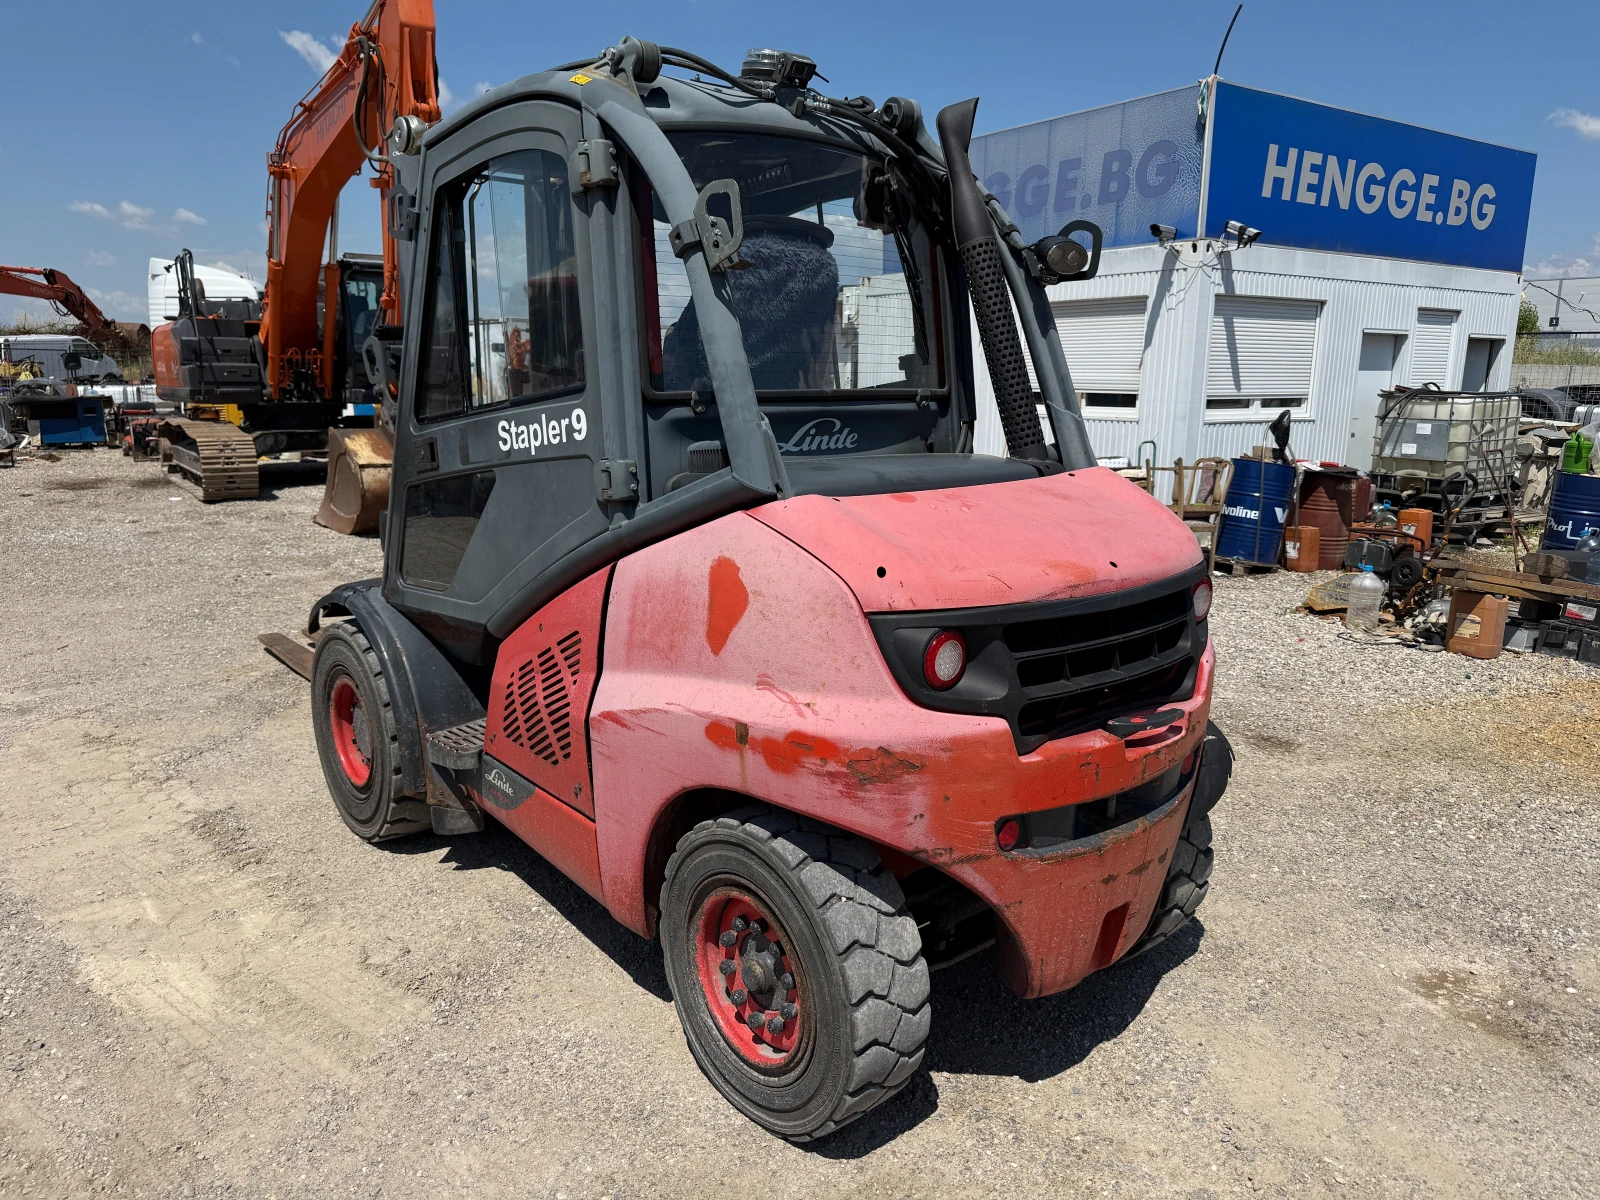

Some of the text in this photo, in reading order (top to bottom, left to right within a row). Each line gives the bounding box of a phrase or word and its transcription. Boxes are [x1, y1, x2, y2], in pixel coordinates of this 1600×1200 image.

[315, 96, 347, 144] HITACHI
[982, 139, 1180, 217] GGE.BG
[1261, 143, 1497, 231] HENGGE.BG
[777, 417, 859, 452] Linde
[1222, 504, 1259, 520] lvoline
[485, 769, 514, 797] Linde
